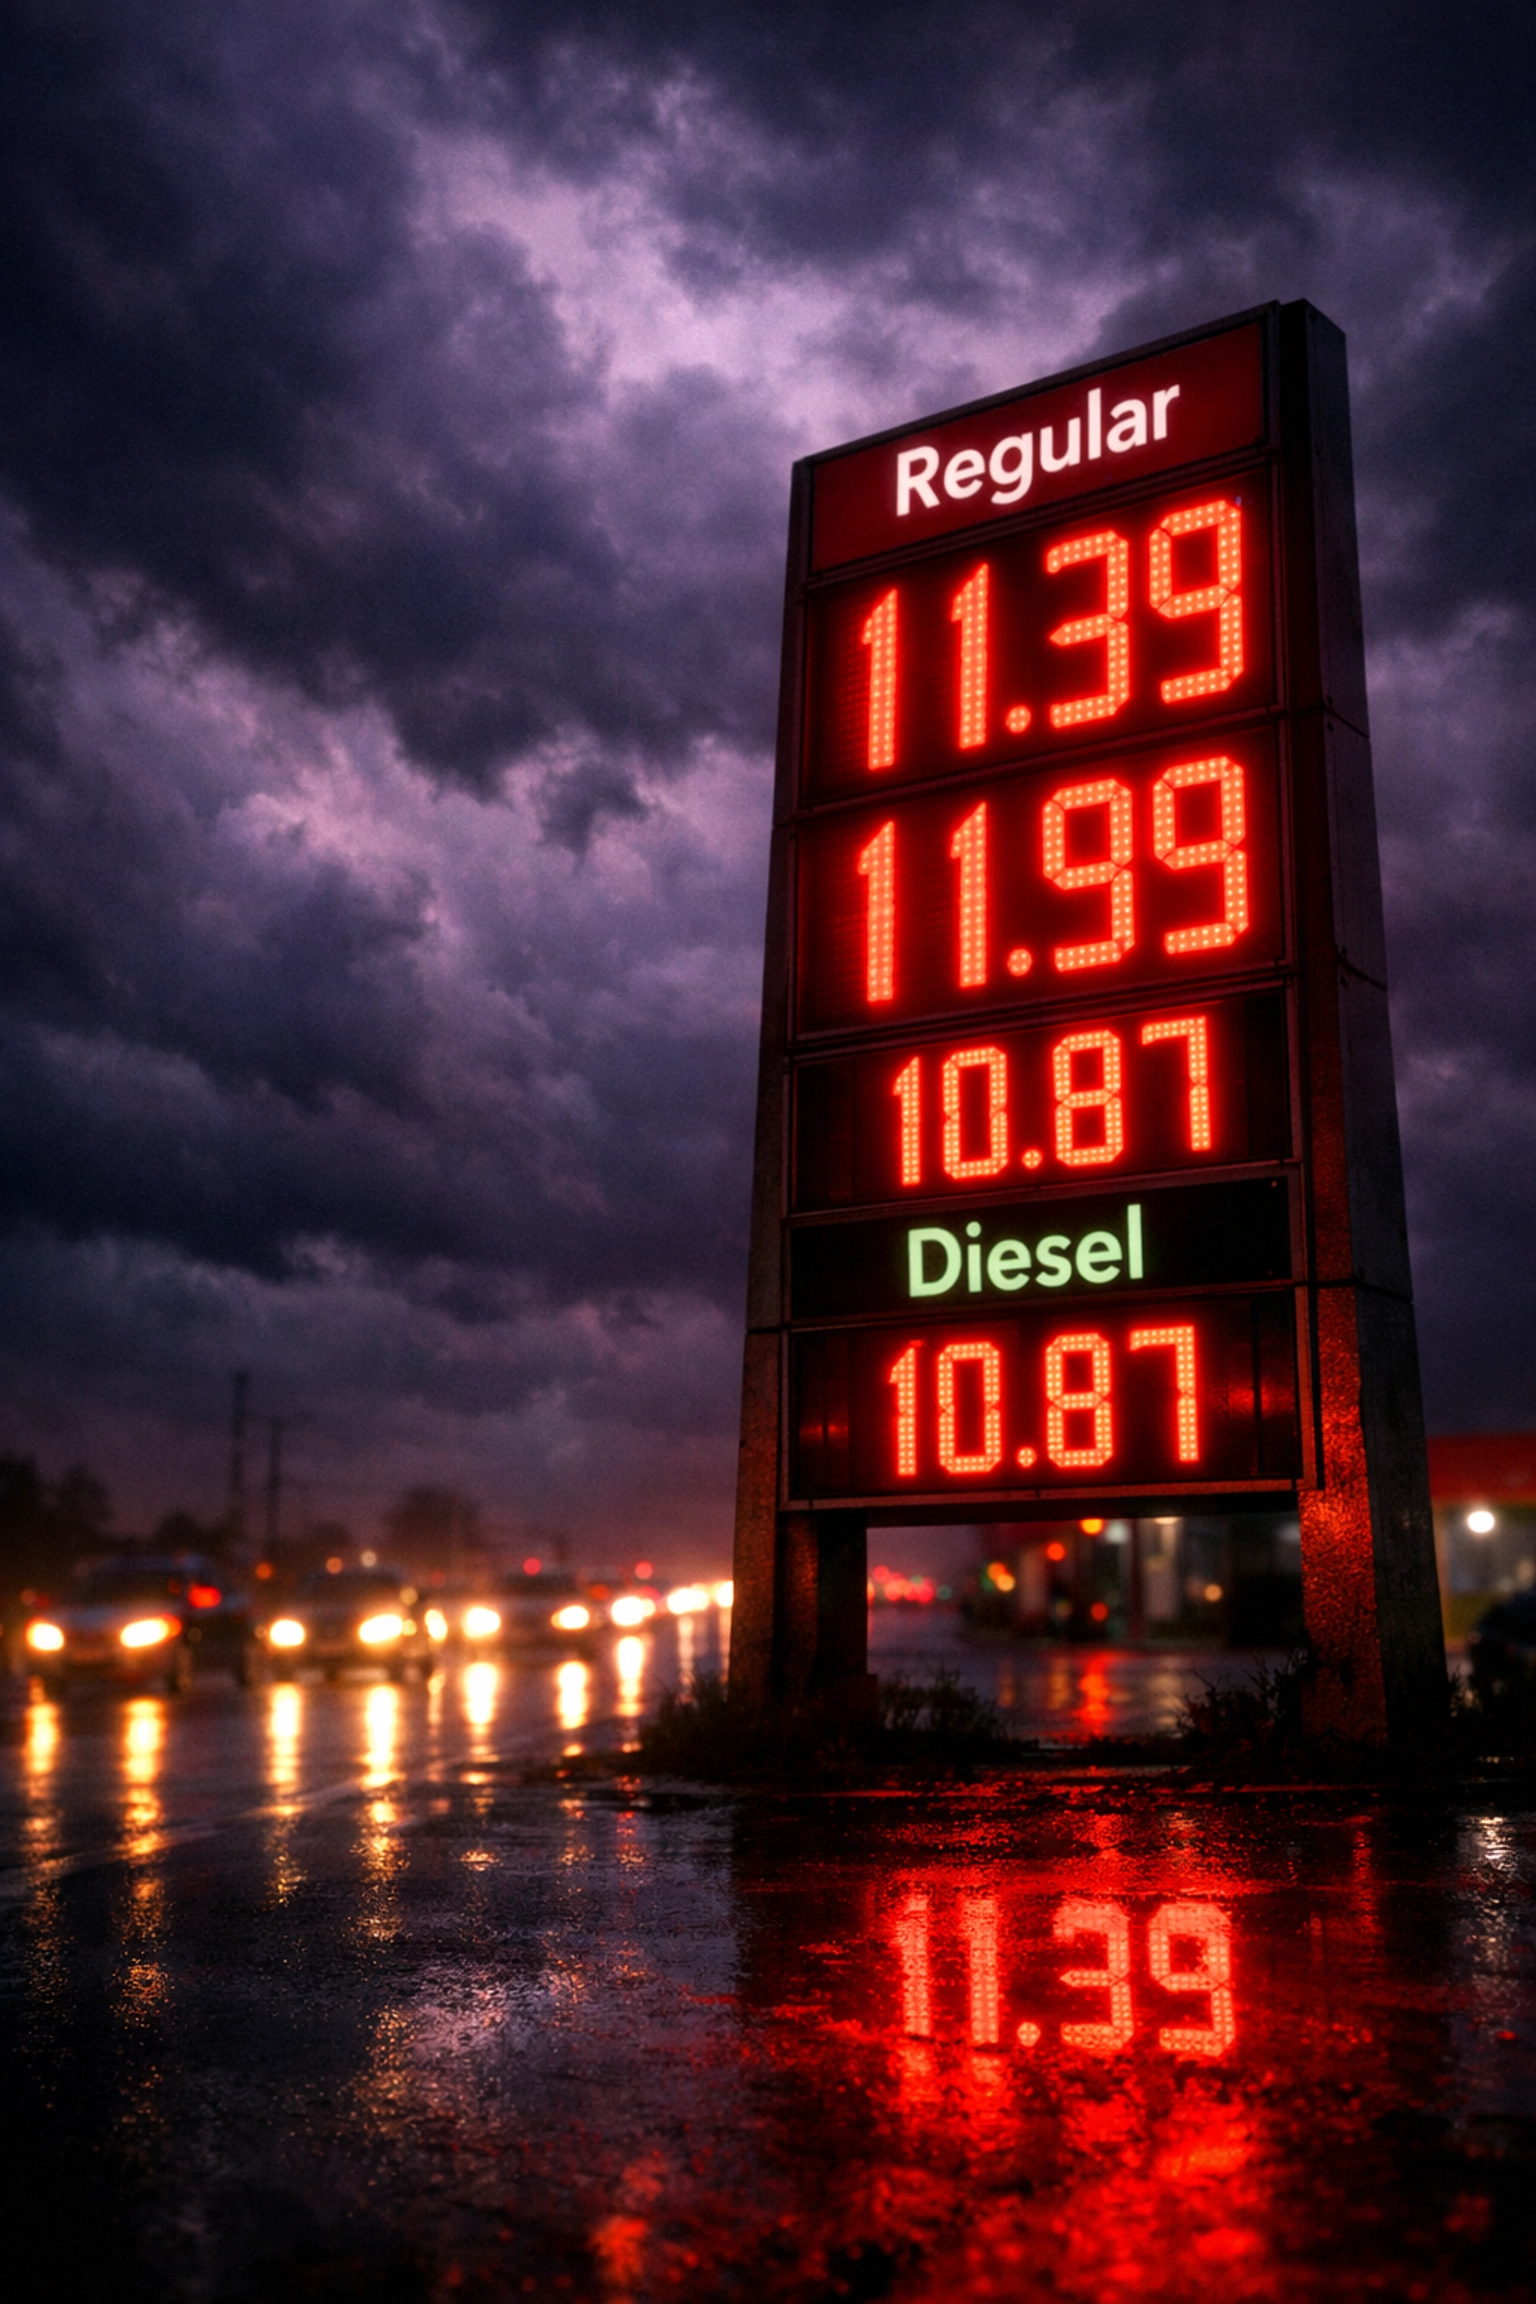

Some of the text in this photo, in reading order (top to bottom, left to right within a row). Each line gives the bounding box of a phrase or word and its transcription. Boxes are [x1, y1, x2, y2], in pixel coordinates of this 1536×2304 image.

[895, 384, 1181, 517] Regular
[861, 499, 1245, 772] 11.39
[857, 755, 1250, 1003] 11.99
[893, 1015, 1211, 1186] 10.87
[907, 1203, 1144, 1298] Diesel
[888, 1325, 1199, 1476] 10.87
